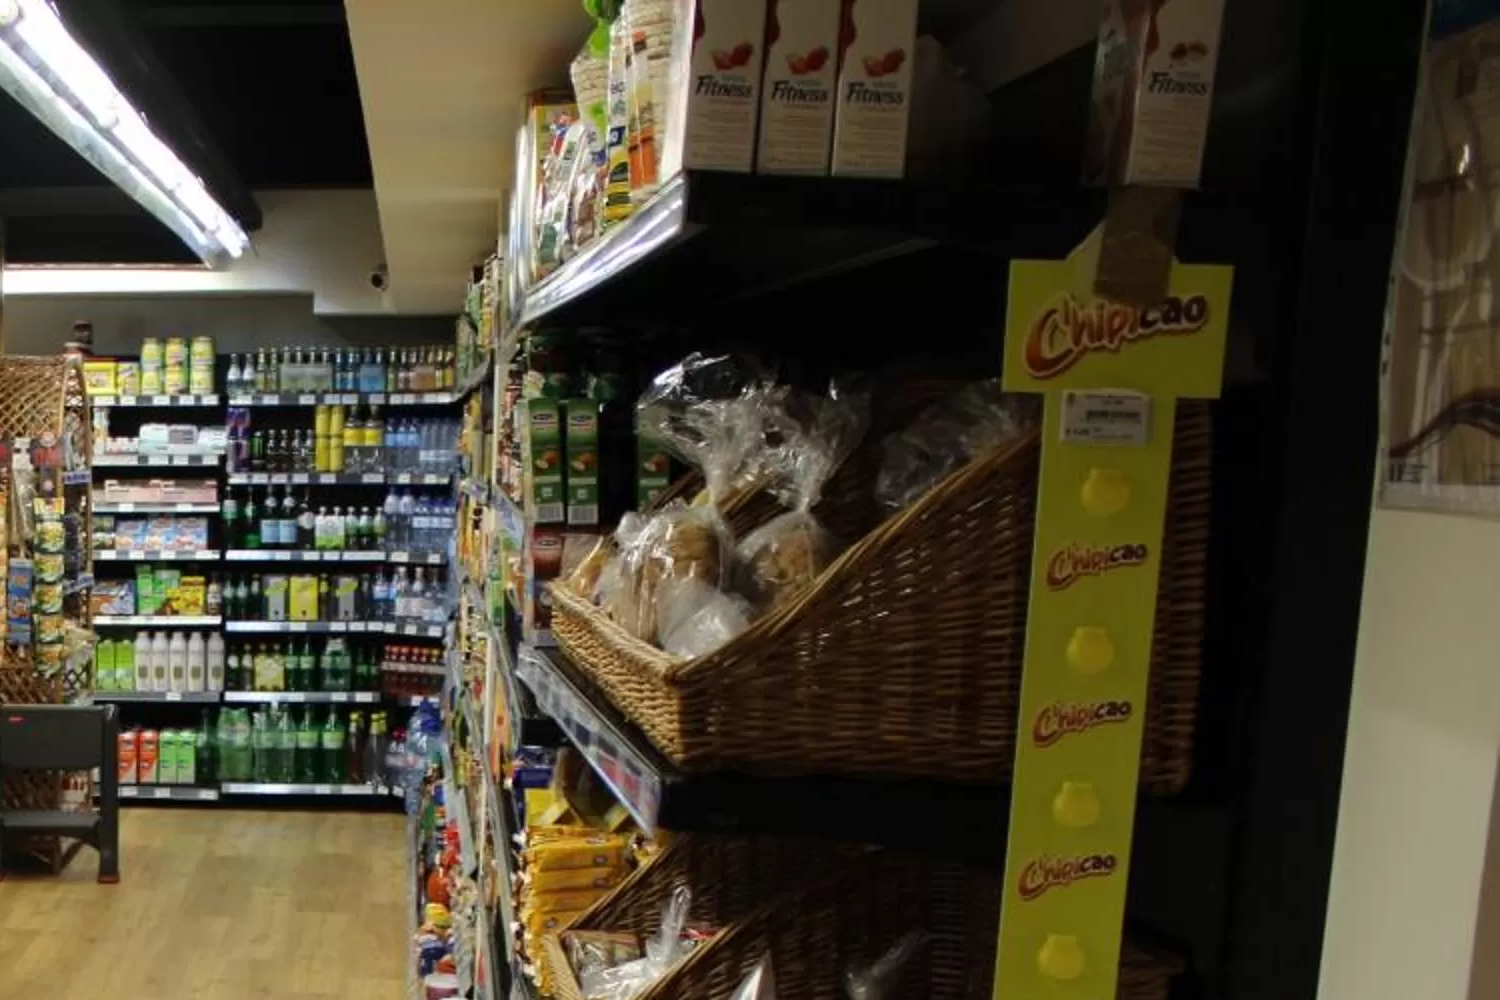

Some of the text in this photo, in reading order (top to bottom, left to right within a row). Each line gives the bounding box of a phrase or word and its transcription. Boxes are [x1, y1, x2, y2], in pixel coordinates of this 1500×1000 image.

[696, 75, 752, 97] Fitness
[771, 79, 828, 102] Fitness
[847, 82, 904, 104] Fitness
[1046, 541, 1149, 592] Chipicao
[1033, 699, 1133, 748] Chipicao
[1018, 852, 1117, 900] Chipicao
